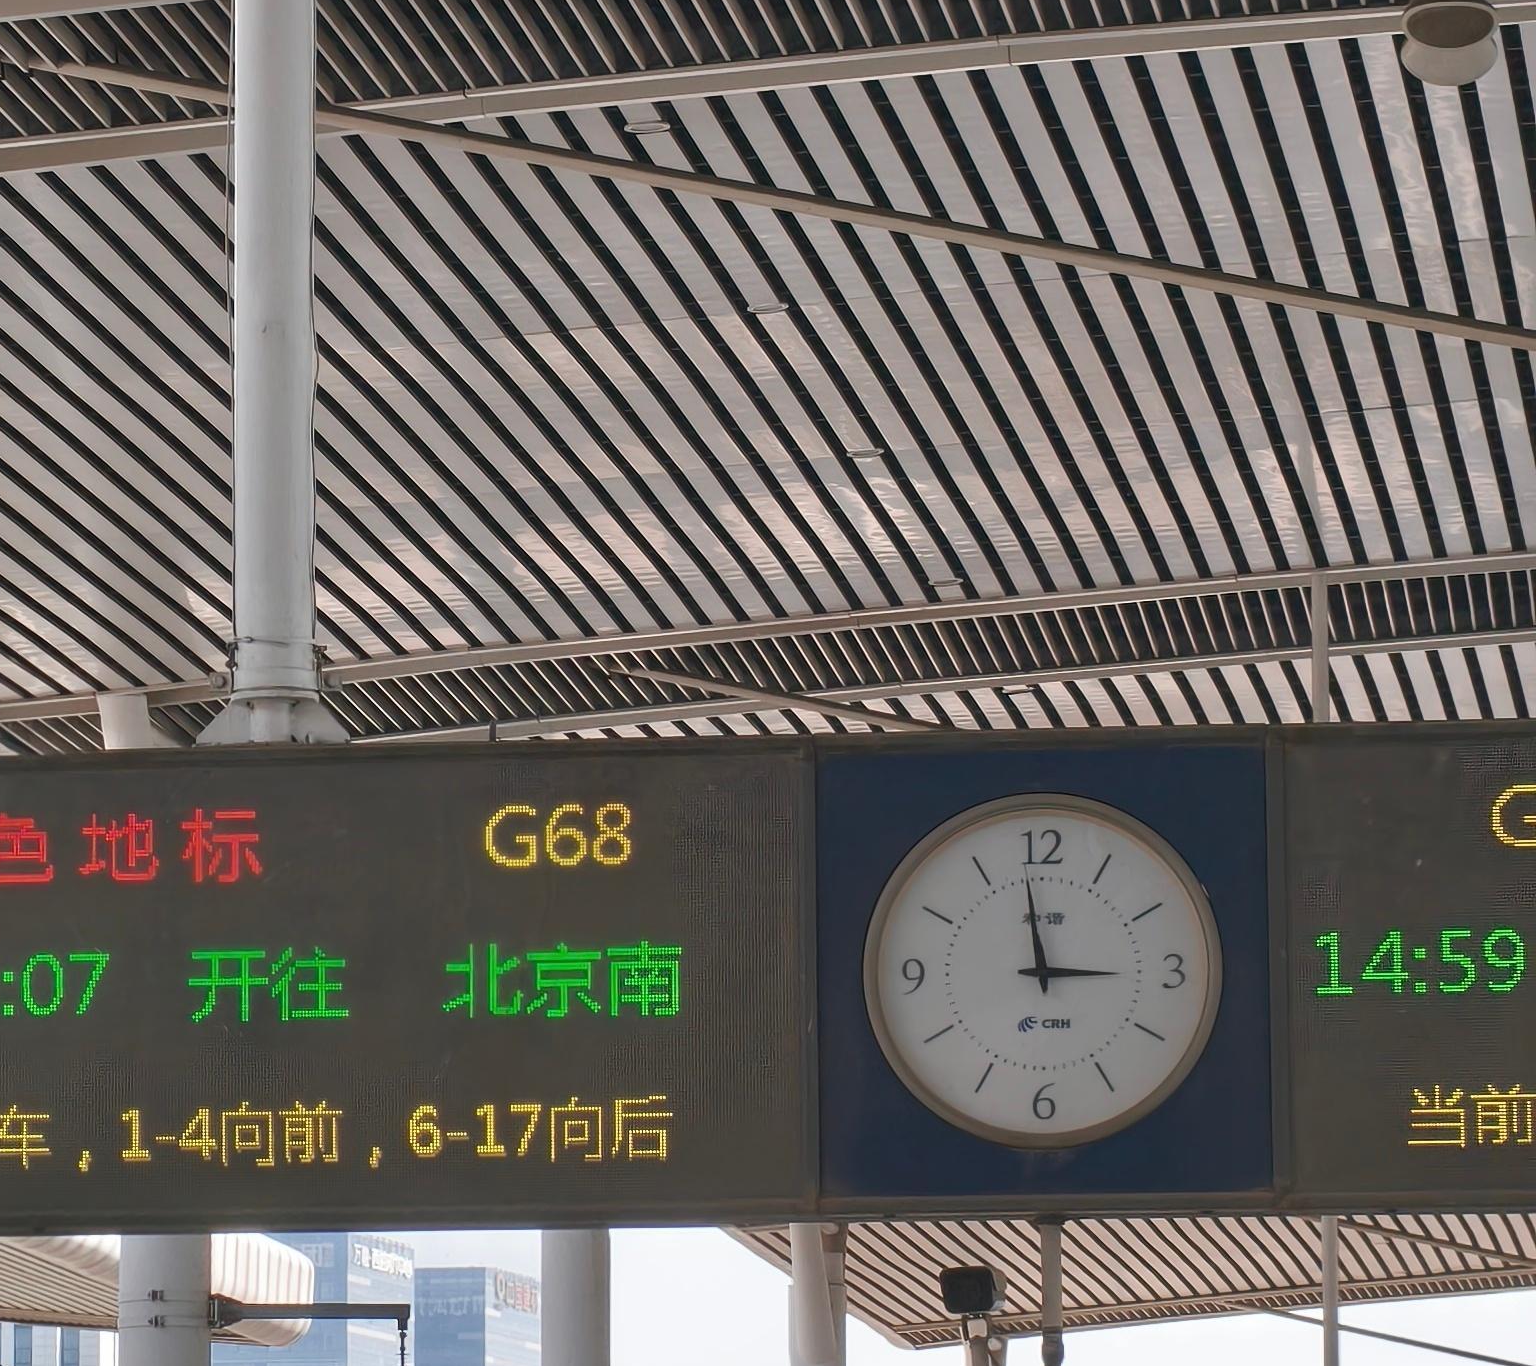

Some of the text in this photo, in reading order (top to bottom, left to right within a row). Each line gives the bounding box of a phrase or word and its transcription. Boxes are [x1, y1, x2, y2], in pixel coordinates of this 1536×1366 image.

[486, 804, 631, 867] G68
[1022, 830, 1063, 865] 12
[902, 959, 925, 994] 9
[1162, 954, 1185, 988] 3
[1315, 927, 1526, 994] 14:59
[188, 948, 347, 1021] 开往
[443, 941, 679, 1019] 北京南
[1041, 1018, 1071, 1029] CRH
[1033, 1083, 1055, 1119] 6
[1408, 1085, 1536, 1146] 当前
